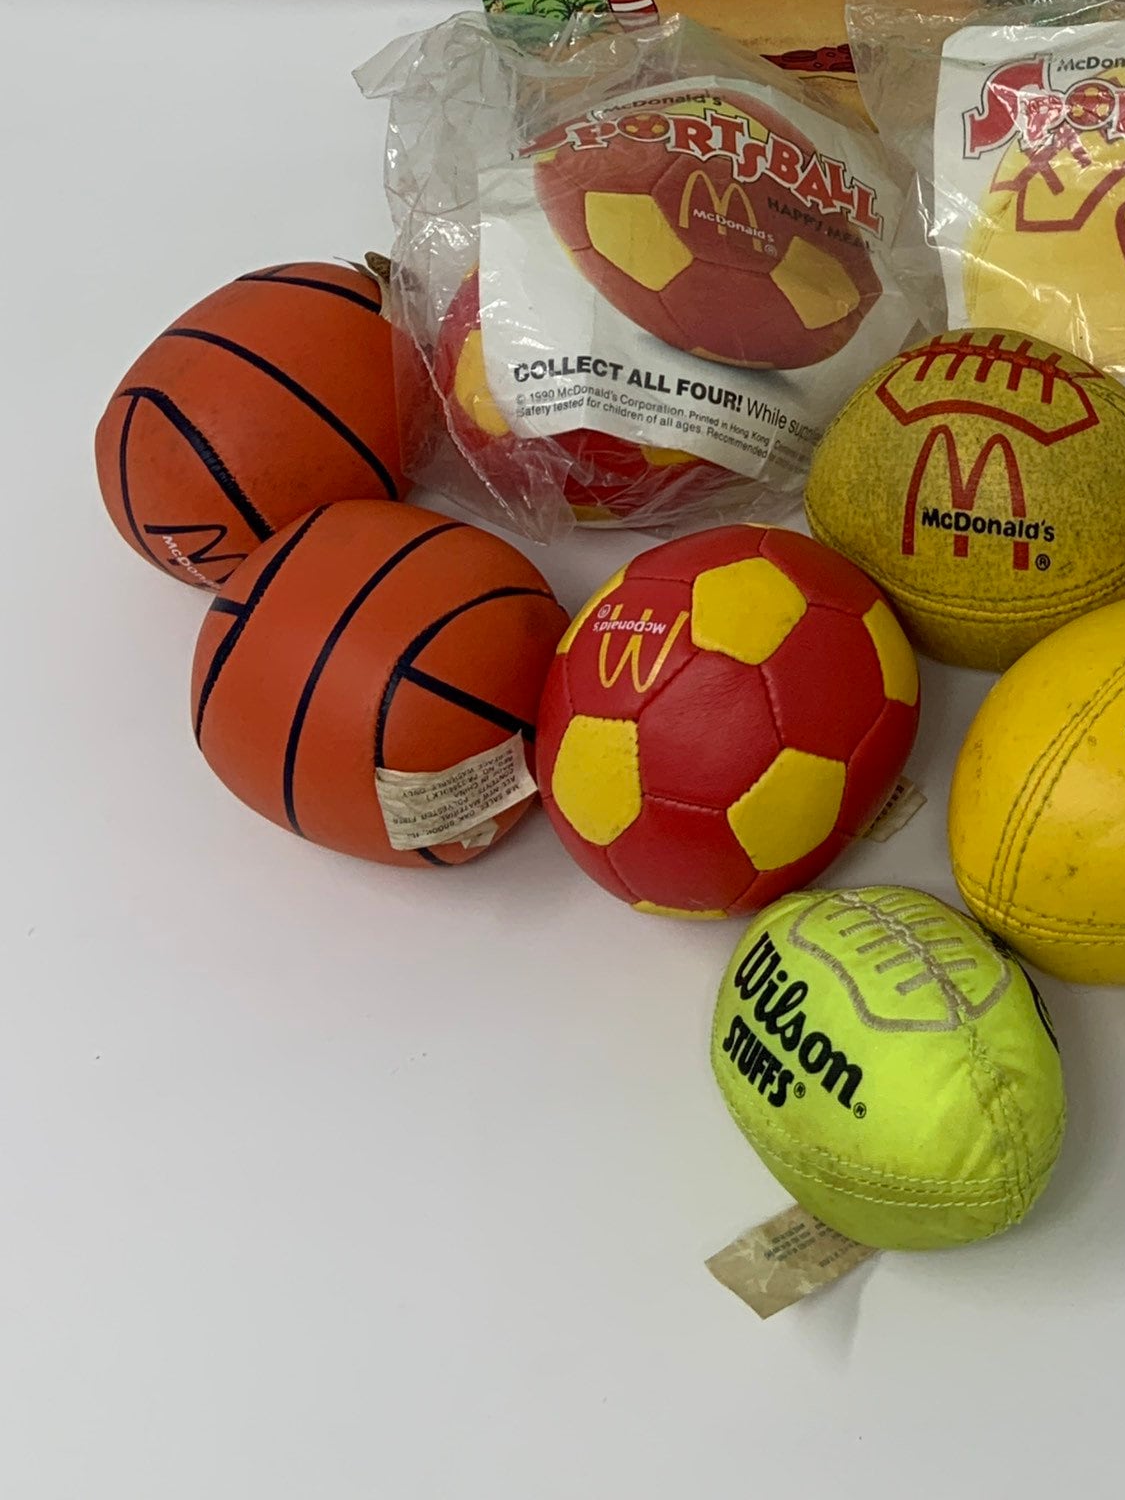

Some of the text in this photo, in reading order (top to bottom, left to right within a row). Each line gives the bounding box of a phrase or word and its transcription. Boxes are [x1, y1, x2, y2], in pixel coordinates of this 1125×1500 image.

[513, 355, 787, 429] COLLECT ALL FOUR! While
[557, 385, 618, 402] McDonald's
[620, 394, 687, 418] Corporation.
[689, 410, 719, 427] Printed
[721, 420, 729, 430] in
[729, 424, 749, 439] Hong
[553, 398, 584, 412] tested
[586, 398, 601, 408] for
[603, 402, 644, 421] children
[645, 414, 657, 424] of
[660, 416, 673, 428] all
[706, 426, 768, 460] Recommended
[922, 506, 1055, 542] McDonald's
[592, 620, 667, 635] McDonald's
